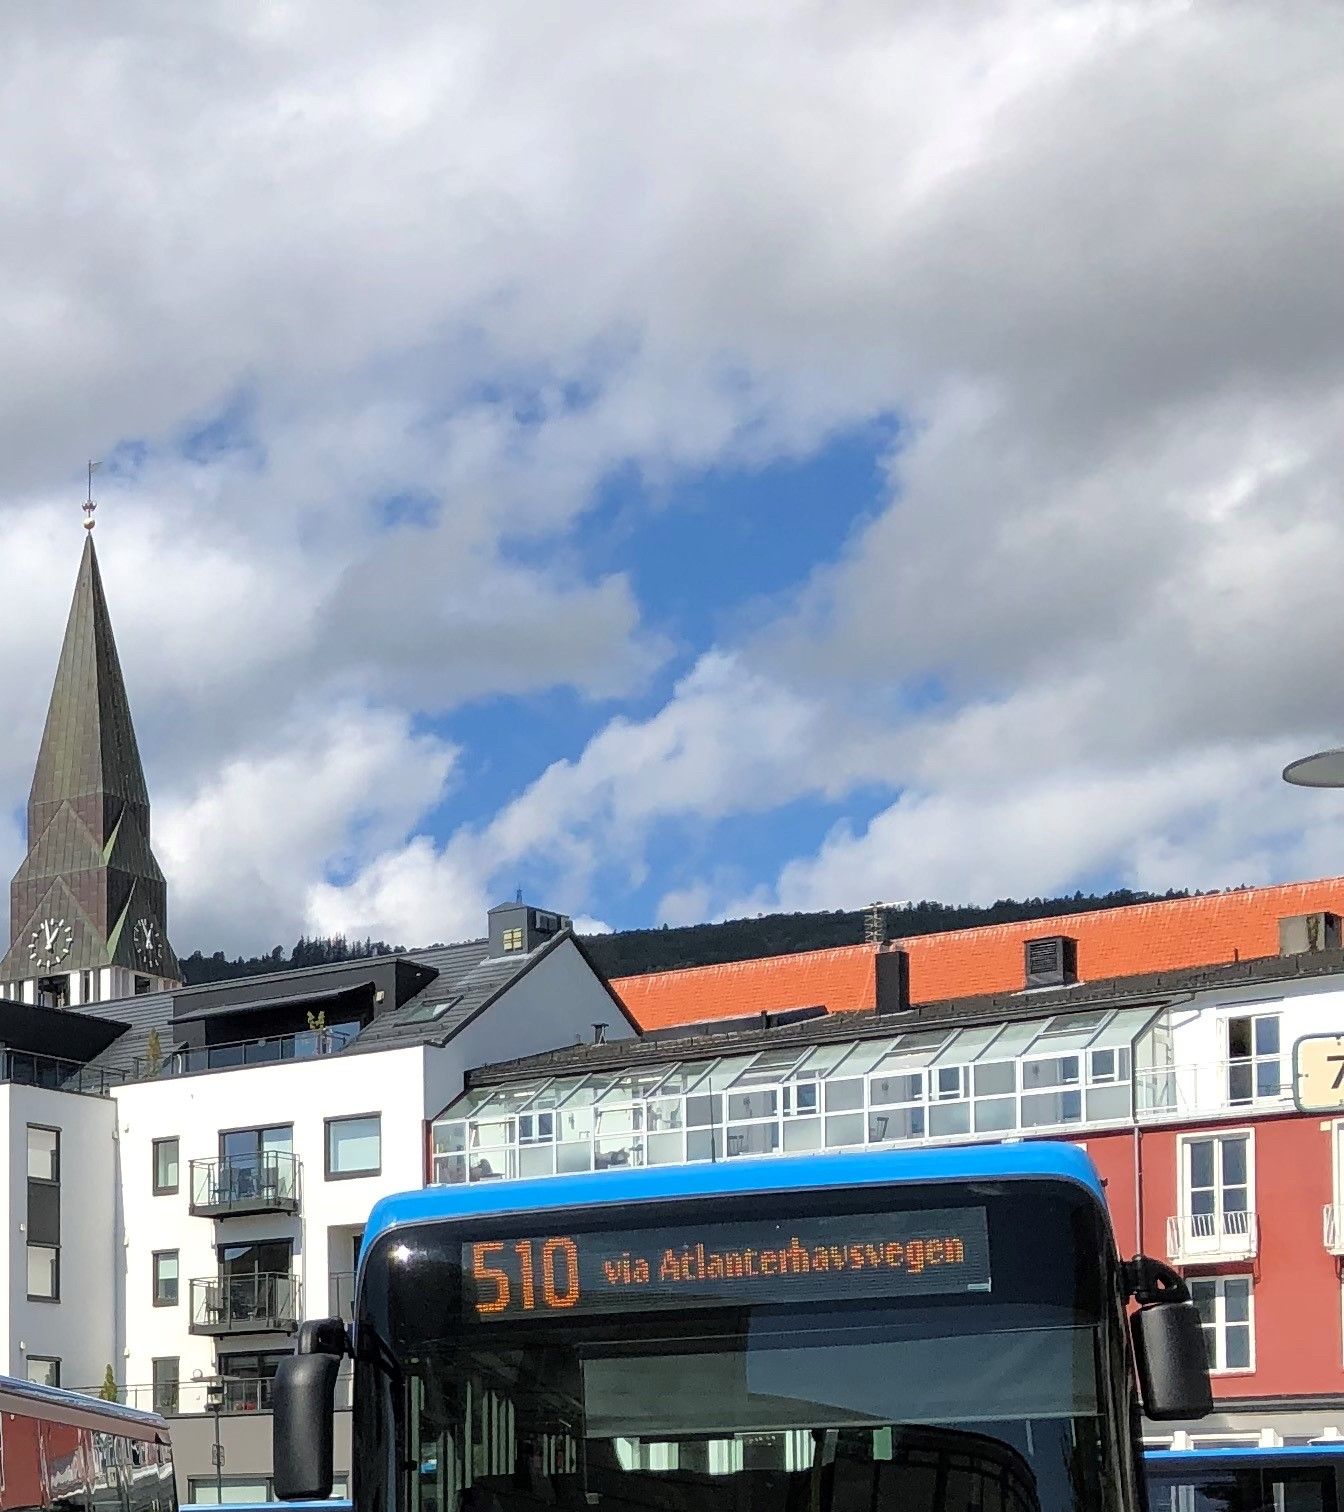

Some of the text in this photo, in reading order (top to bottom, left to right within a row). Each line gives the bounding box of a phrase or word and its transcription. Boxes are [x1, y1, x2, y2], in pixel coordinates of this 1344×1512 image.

[472, 1234, 966, 1314] 510 via Atlanterhavsvegen
